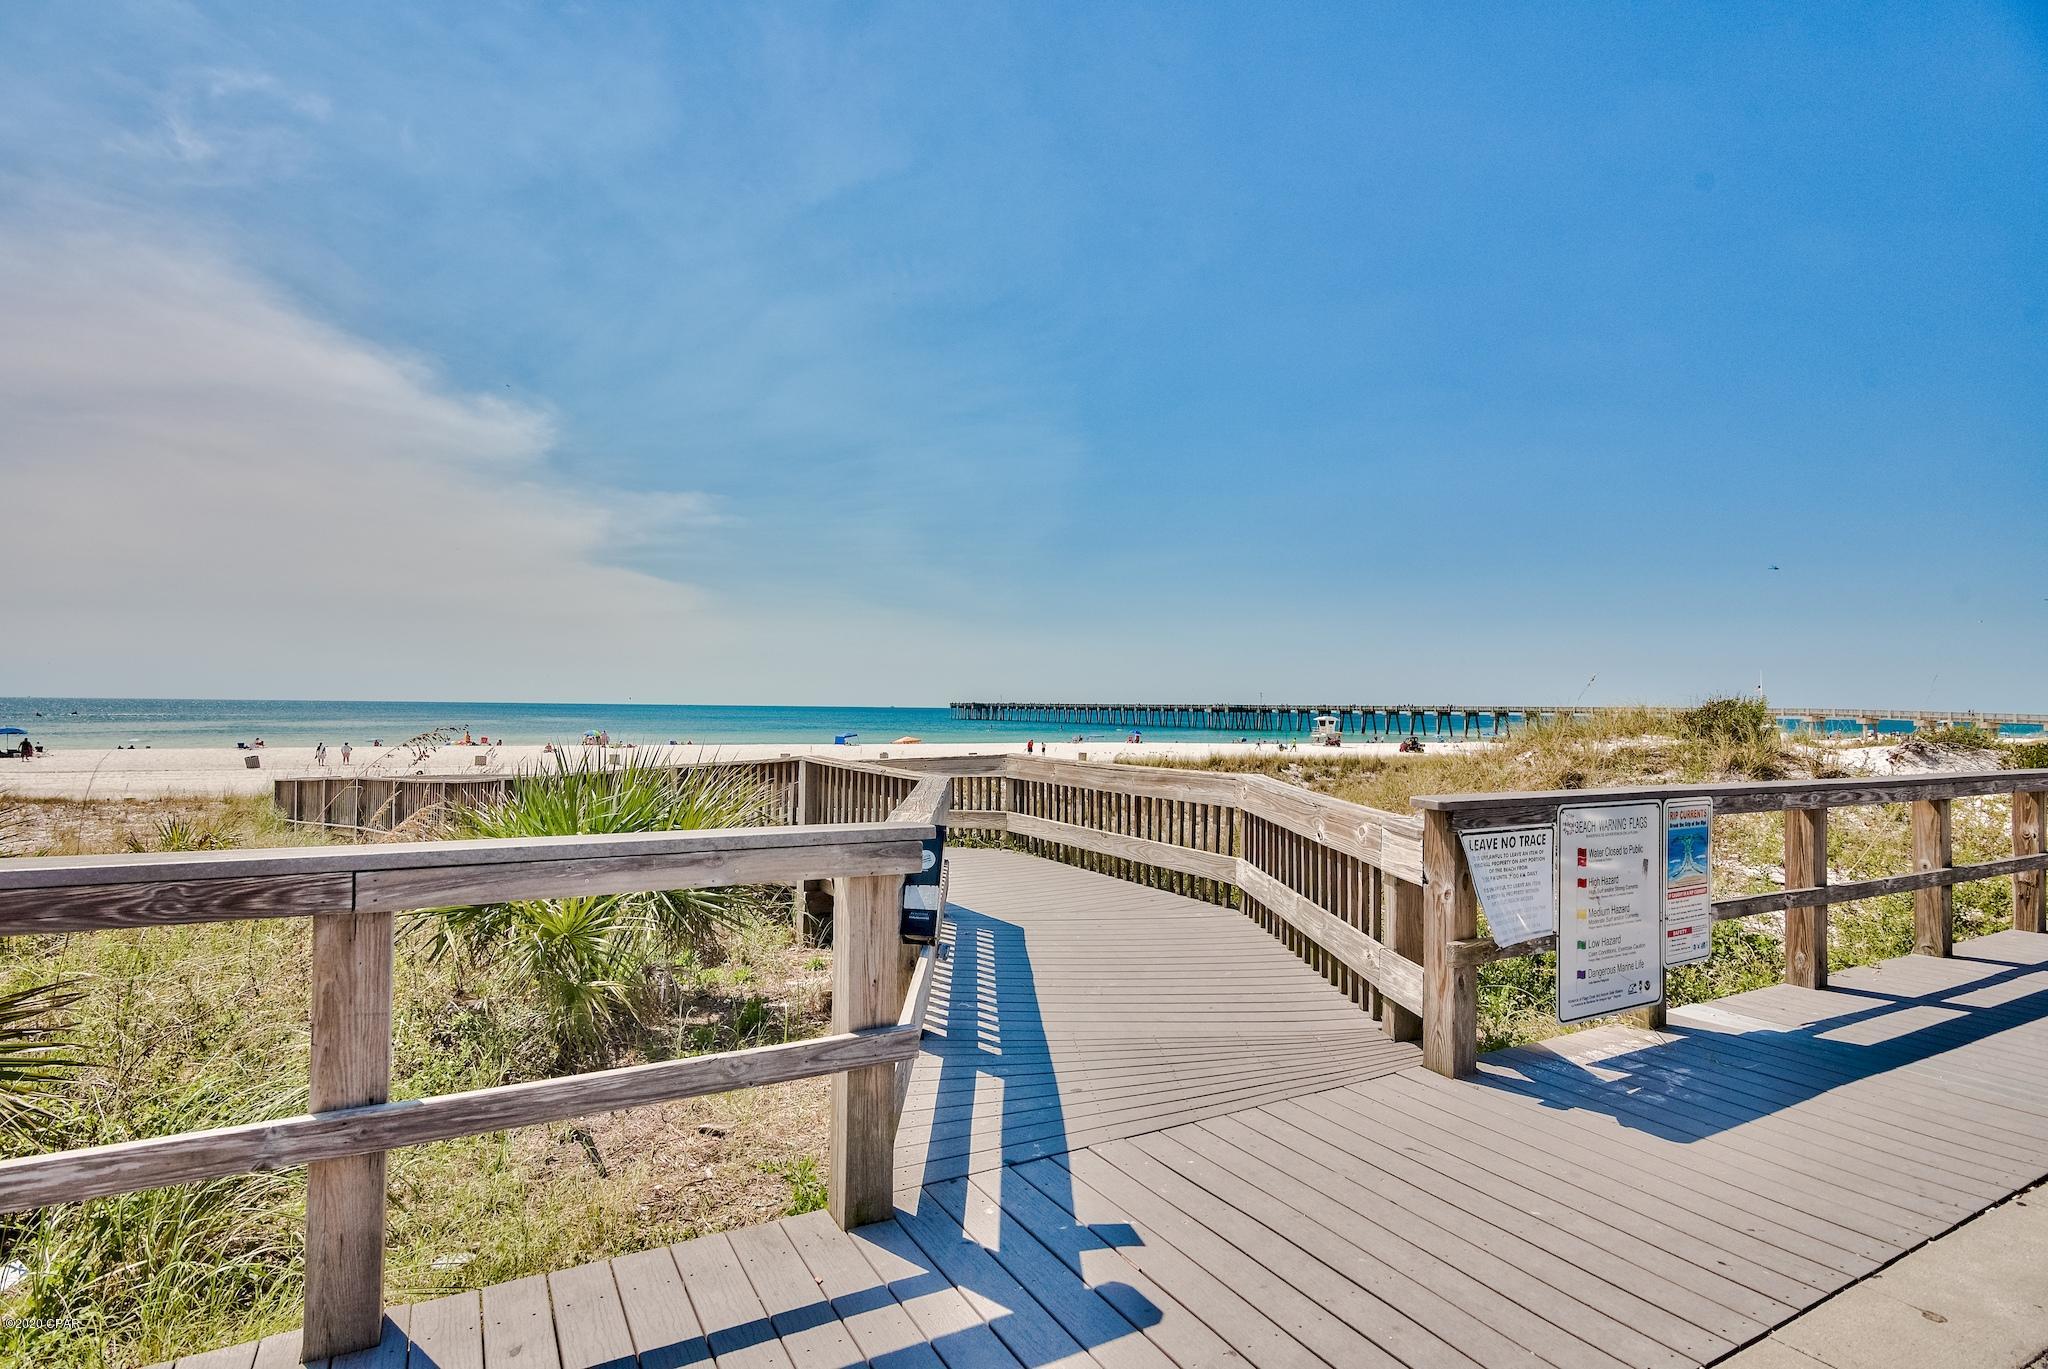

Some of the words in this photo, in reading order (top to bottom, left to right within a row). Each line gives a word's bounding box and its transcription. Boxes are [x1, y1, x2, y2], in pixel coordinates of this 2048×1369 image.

[1669, 811, 1678, 820] RIP
[1680, 809, 1707, 820] CURRENTS
[1574, 820, 1596, 834] BEACH
[1599, 817, 1627, 832] WARNING
[1629, 816, 1648, 829] FLAGS
[1469, 838, 1498, 851] LEAVE
[1501, 836, 1516, 848] NO
[1520, 834, 1546, 848] TRACE
[1589, 848, 1604, 858] Water
[1605, 846, 1622, 857] Closed
[1623, 847, 1628, 855] to
[1629, 844, 1644, 854] Public
[1588, 877, 1600, 888] High
[1601, 875, 1619, 885] Hazard
[1588, 906, 1610, 917] Medium
[1611, 903, 1630, 914] Hazard
[1588, 940, 1600, 949] Low
[1601, 936, 1621, 946] Hazard
[1588, 966, 1616, 979] Dangerous
[1617, 962, 1634, 973] Marine
[1635, 959, 1645, 969] Life
